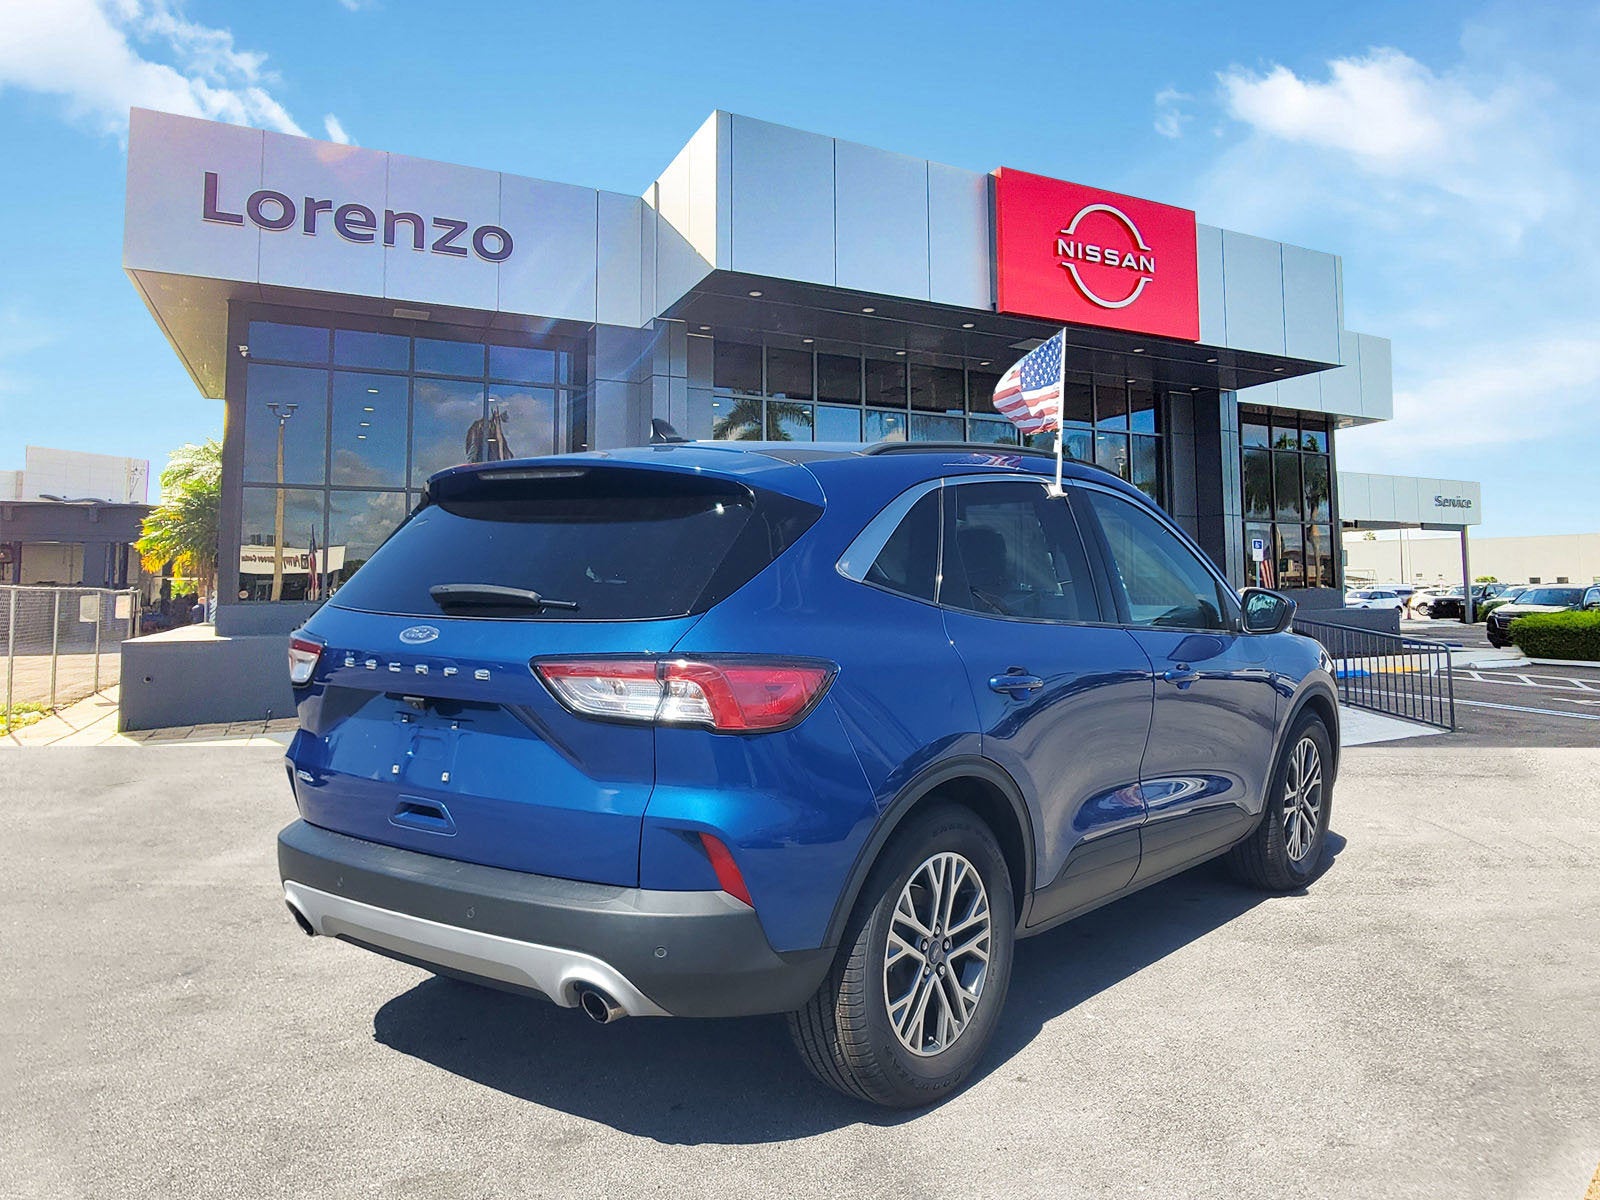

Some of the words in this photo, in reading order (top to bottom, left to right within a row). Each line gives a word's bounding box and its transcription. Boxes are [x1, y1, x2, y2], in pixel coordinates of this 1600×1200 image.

[202, 171, 515, 263] Lorenzo
[1057, 238, 1155, 273] NISSAN
[1434, 495, 1472, 509] Service
[344, 657, 491, 681] ESCAPE
